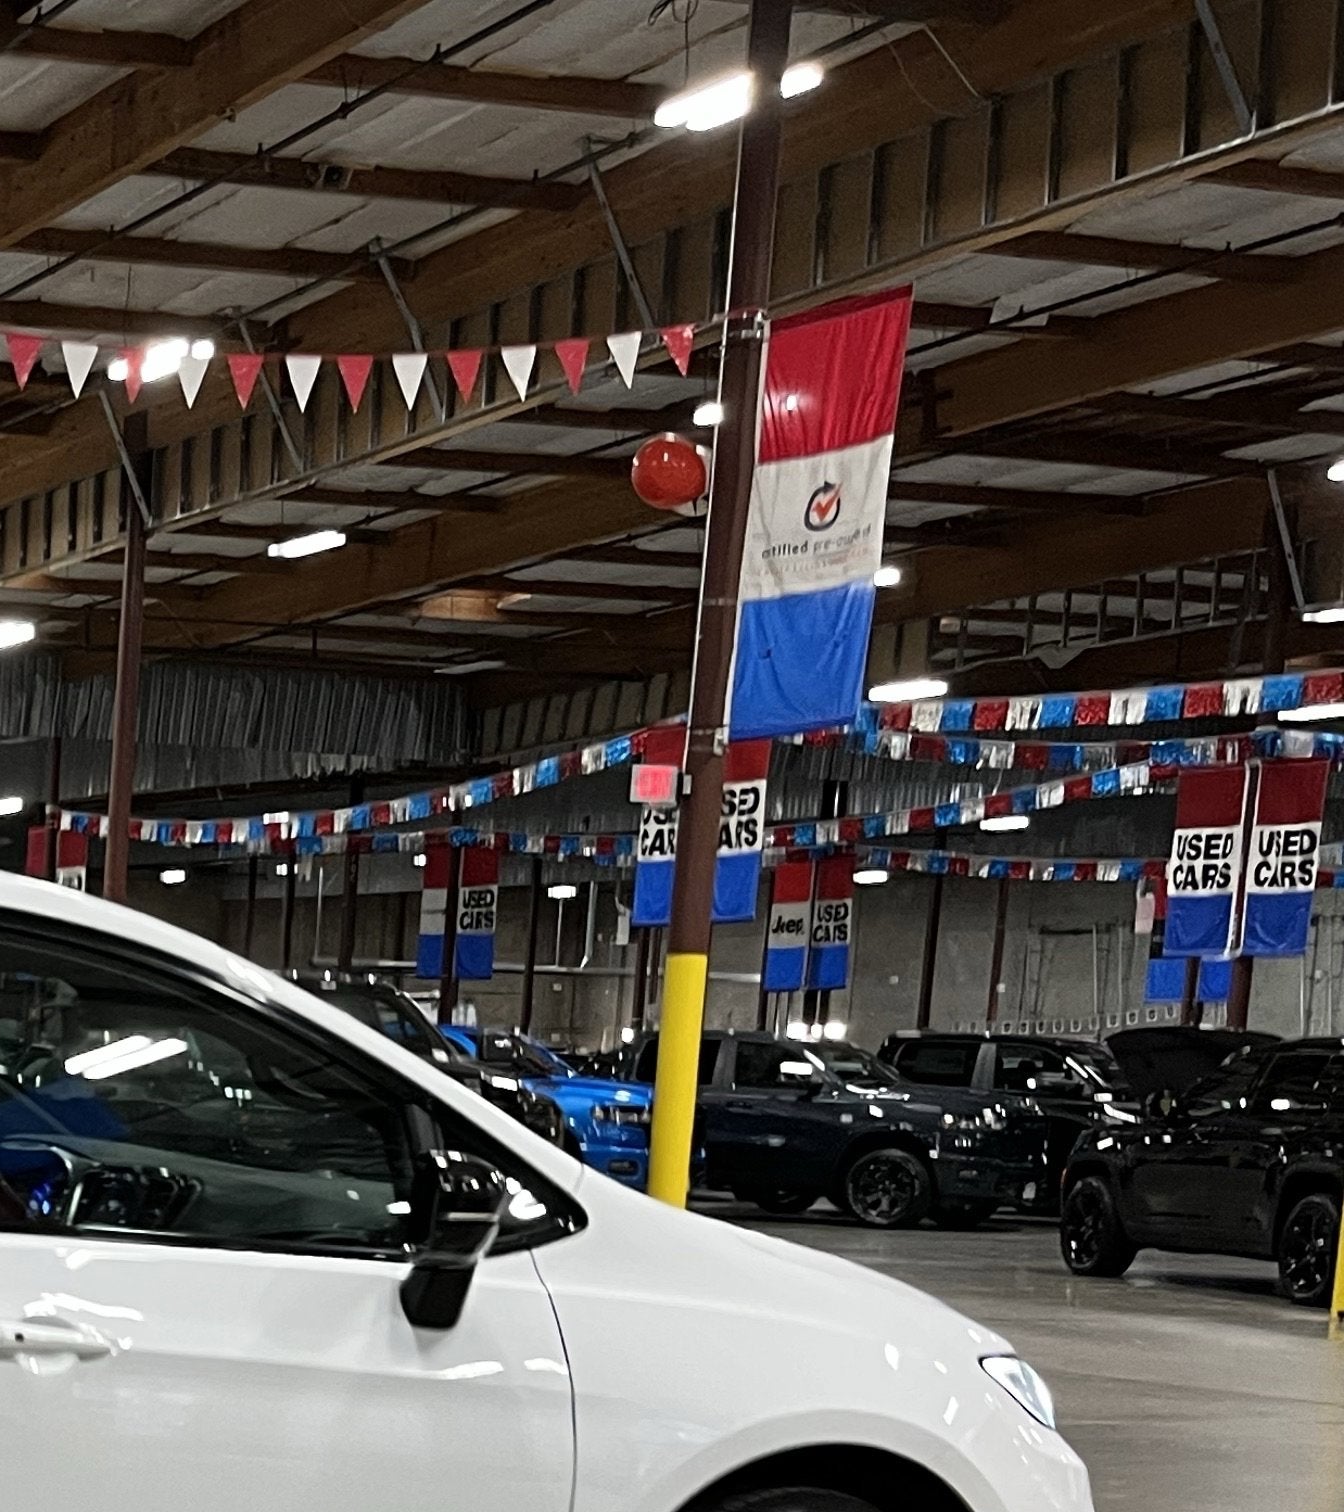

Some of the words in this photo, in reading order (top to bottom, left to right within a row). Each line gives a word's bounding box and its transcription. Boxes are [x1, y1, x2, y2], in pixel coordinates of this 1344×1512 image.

[721, 786, 760, 816] SED
[641, 828, 676, 856] CAR
[719, 818, 758, 849] ARS
[1177, 832, 1234, 861] USED
[1259, 829, 1317, 857] USED
[1173, 862, 1231, 890] CARS
[1254, 859, 1314, 887] CARS
[462, 889, 495, 909] USED
